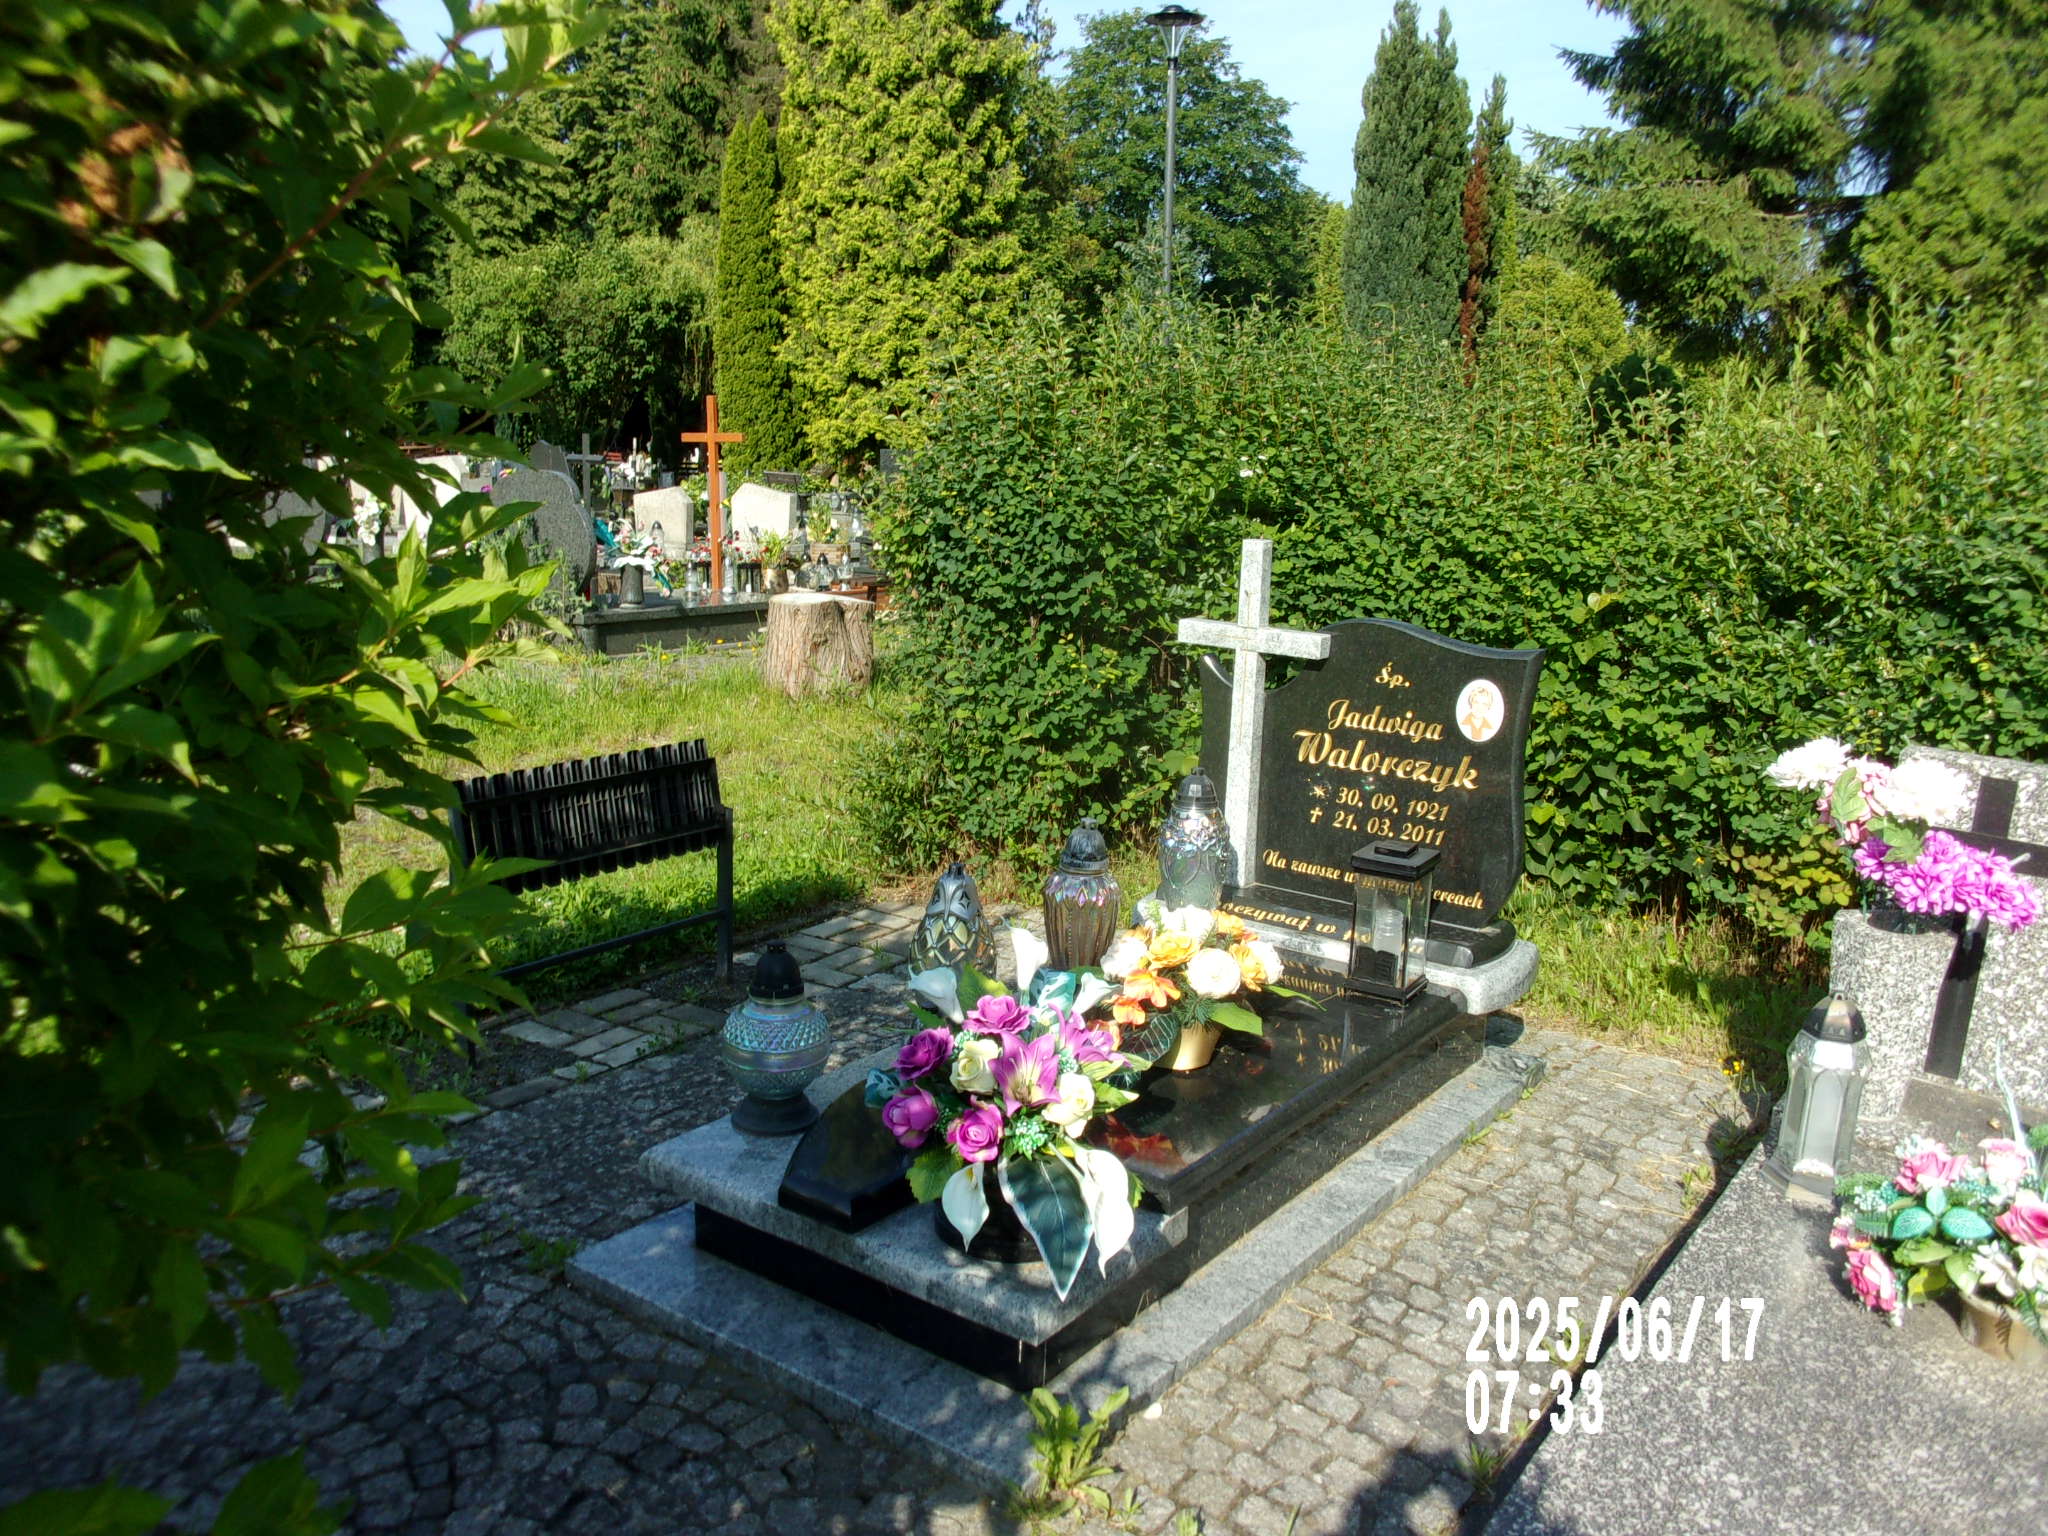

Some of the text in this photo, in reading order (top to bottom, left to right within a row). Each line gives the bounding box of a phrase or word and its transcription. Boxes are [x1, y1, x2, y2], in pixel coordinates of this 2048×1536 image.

[1327, 698, 1446, 744] Jadwiga
[1292, 729, 1480, 793] Walorczyk
[1335, 786, 1451, 821] 30. 09. 1921
[1332, 810, 1447, 846] 21. 03. 2011
[1262, 849, 1288, 869] Na
[1290, 859, 1341, 880] zawsze
[1432, 888, 1484, 910] ercach
